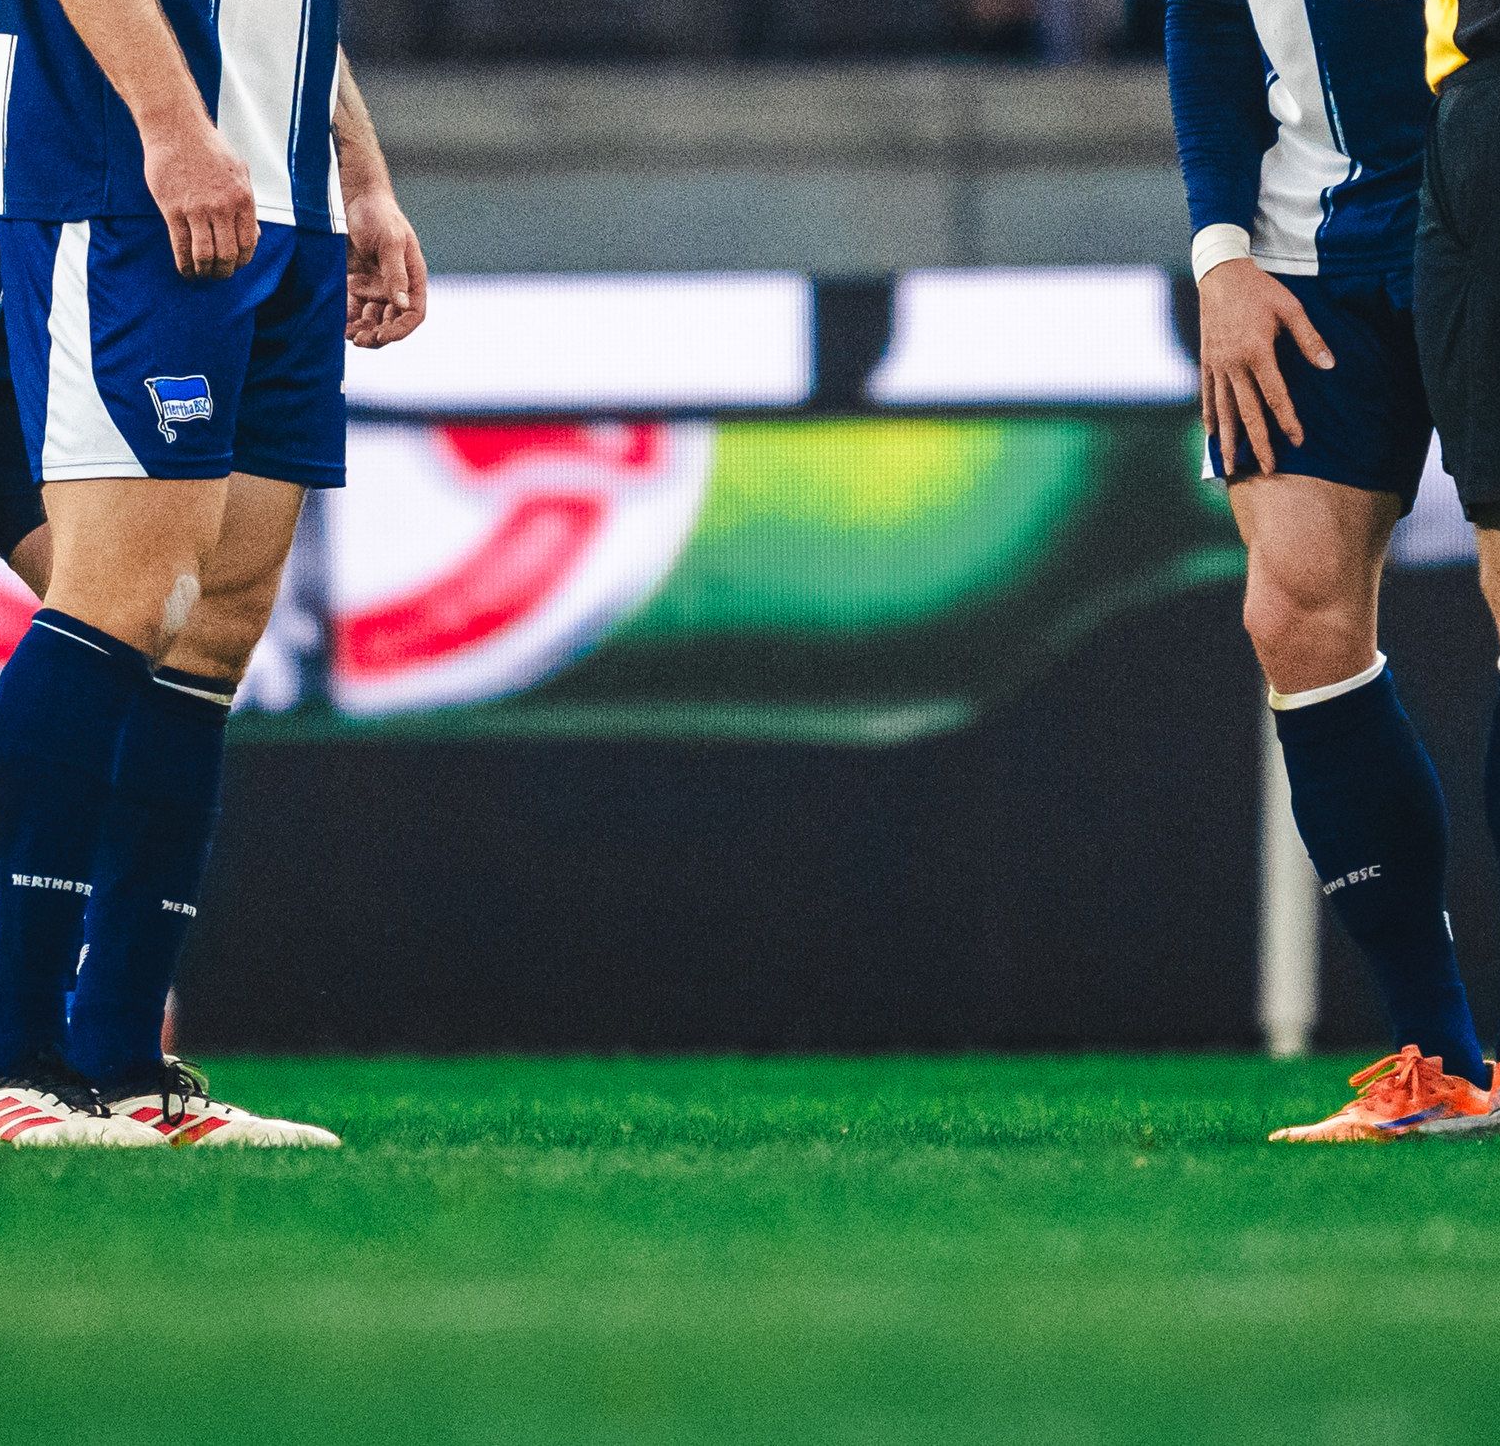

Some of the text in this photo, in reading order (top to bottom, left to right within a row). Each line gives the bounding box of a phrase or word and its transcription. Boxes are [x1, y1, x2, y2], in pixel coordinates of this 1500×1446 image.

[163, 399, 209, 417] Hertha BSC
[11, 873, 73, 892] HERTHA
[1346, 864, 1382, 885] BSC
